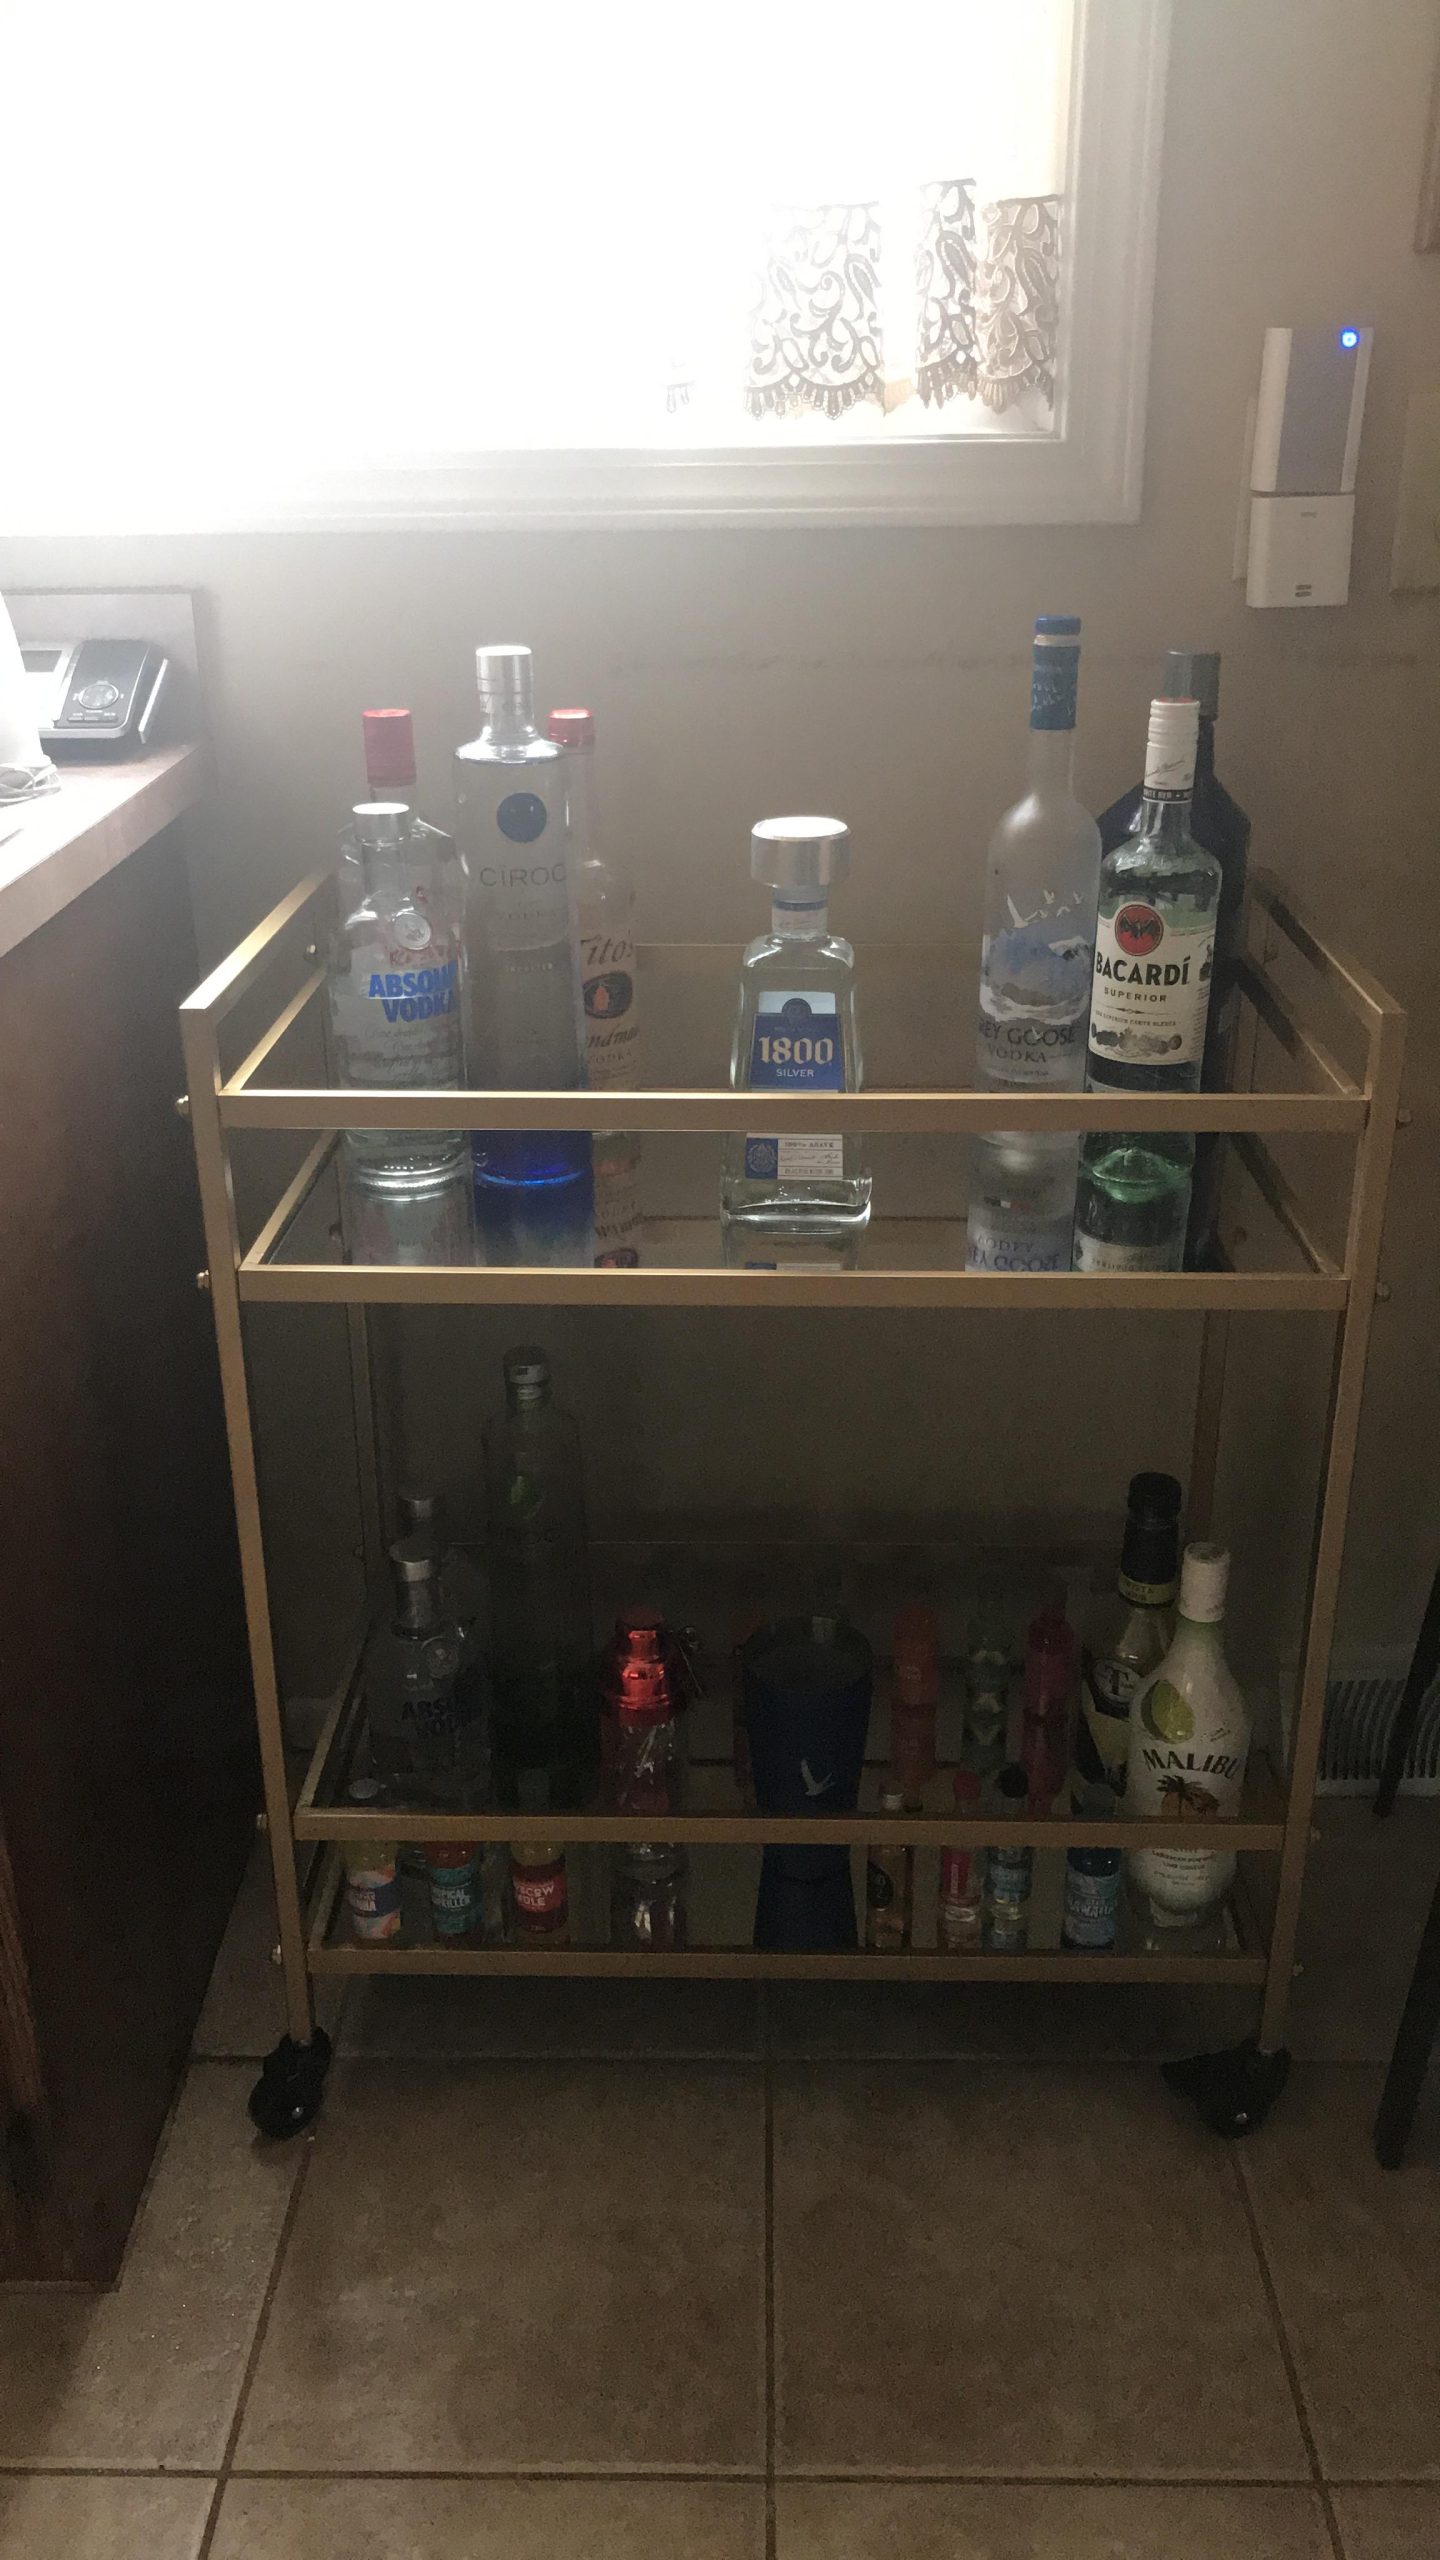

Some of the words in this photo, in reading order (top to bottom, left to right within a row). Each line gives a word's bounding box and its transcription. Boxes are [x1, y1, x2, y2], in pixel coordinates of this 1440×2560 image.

[1095, 951, 1191, 987] BACARDÍ
[1104, 986, 1168, 1003] SUPERIOR
[758, 1035, 834, 1065] 1800
[989, 1044, 1047, 1063] VODKA
[775, 1068, 815, 1078] SILVER
[1143, 1749, 1238, 1780] MALIBU
